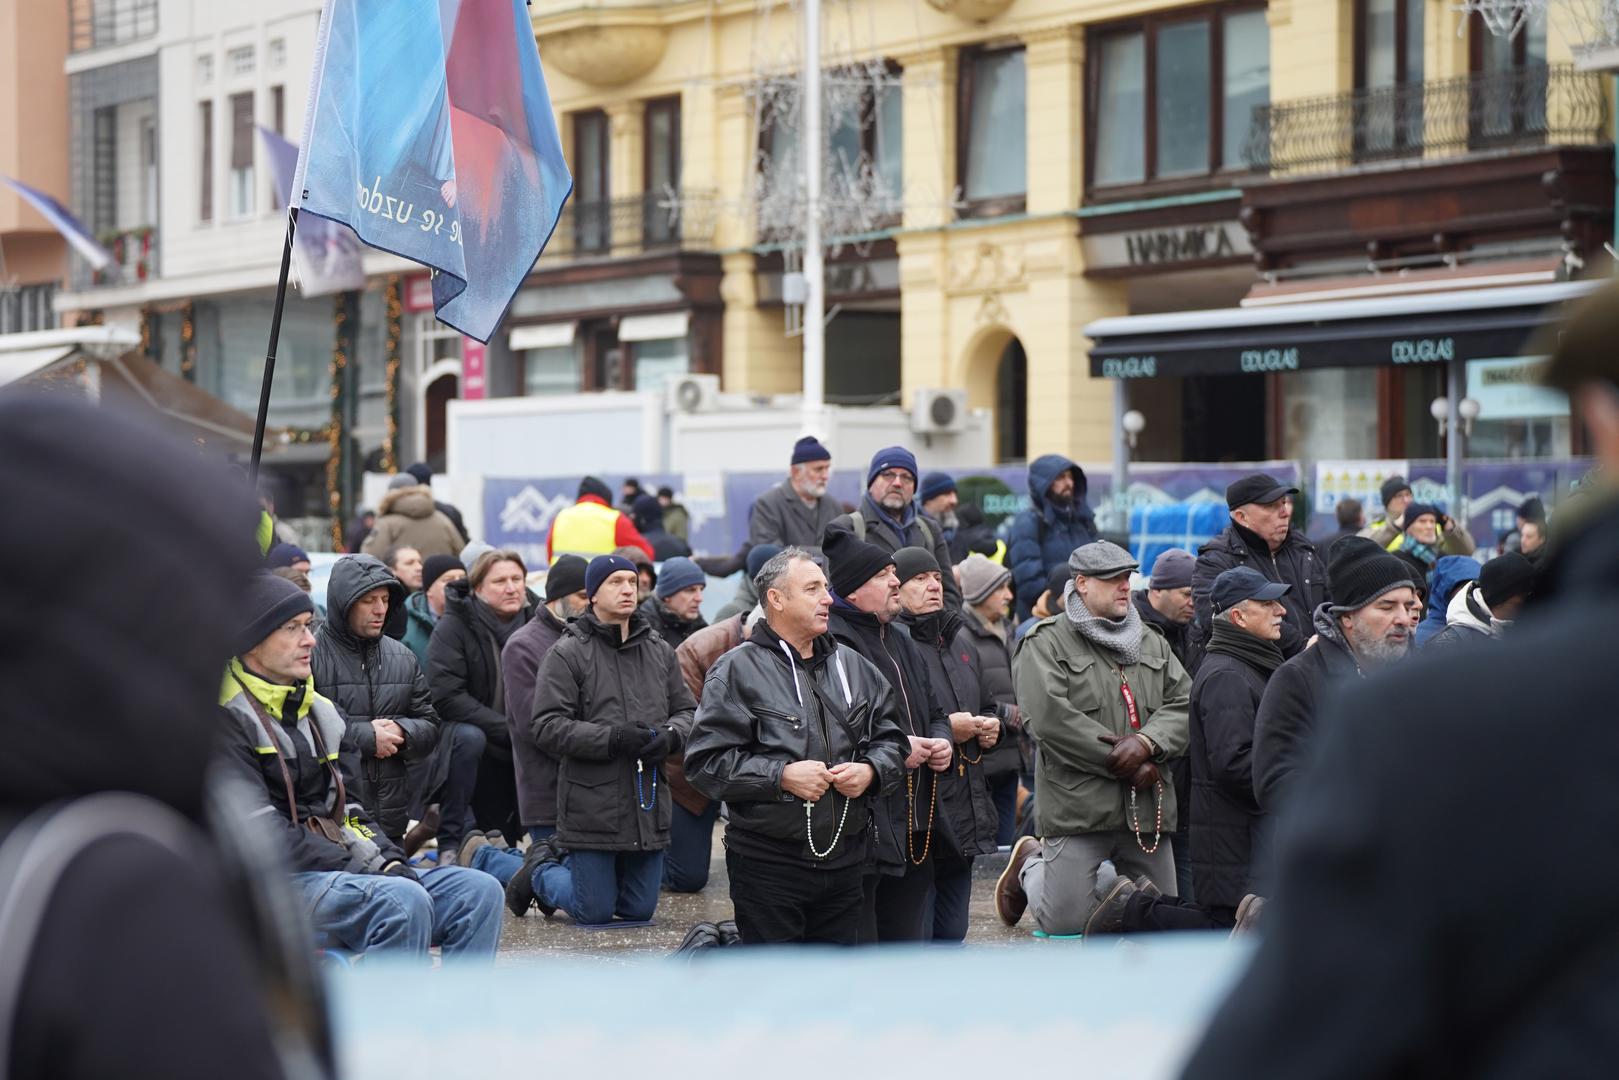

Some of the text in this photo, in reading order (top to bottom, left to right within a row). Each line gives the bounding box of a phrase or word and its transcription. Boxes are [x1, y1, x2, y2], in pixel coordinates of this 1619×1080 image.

[1240, 347, 1300, 373] DOUGLAS
[1391, 338, 1455, 363] DOUGLAS
[1102, 356, 1158, 378] DOUGLAS
